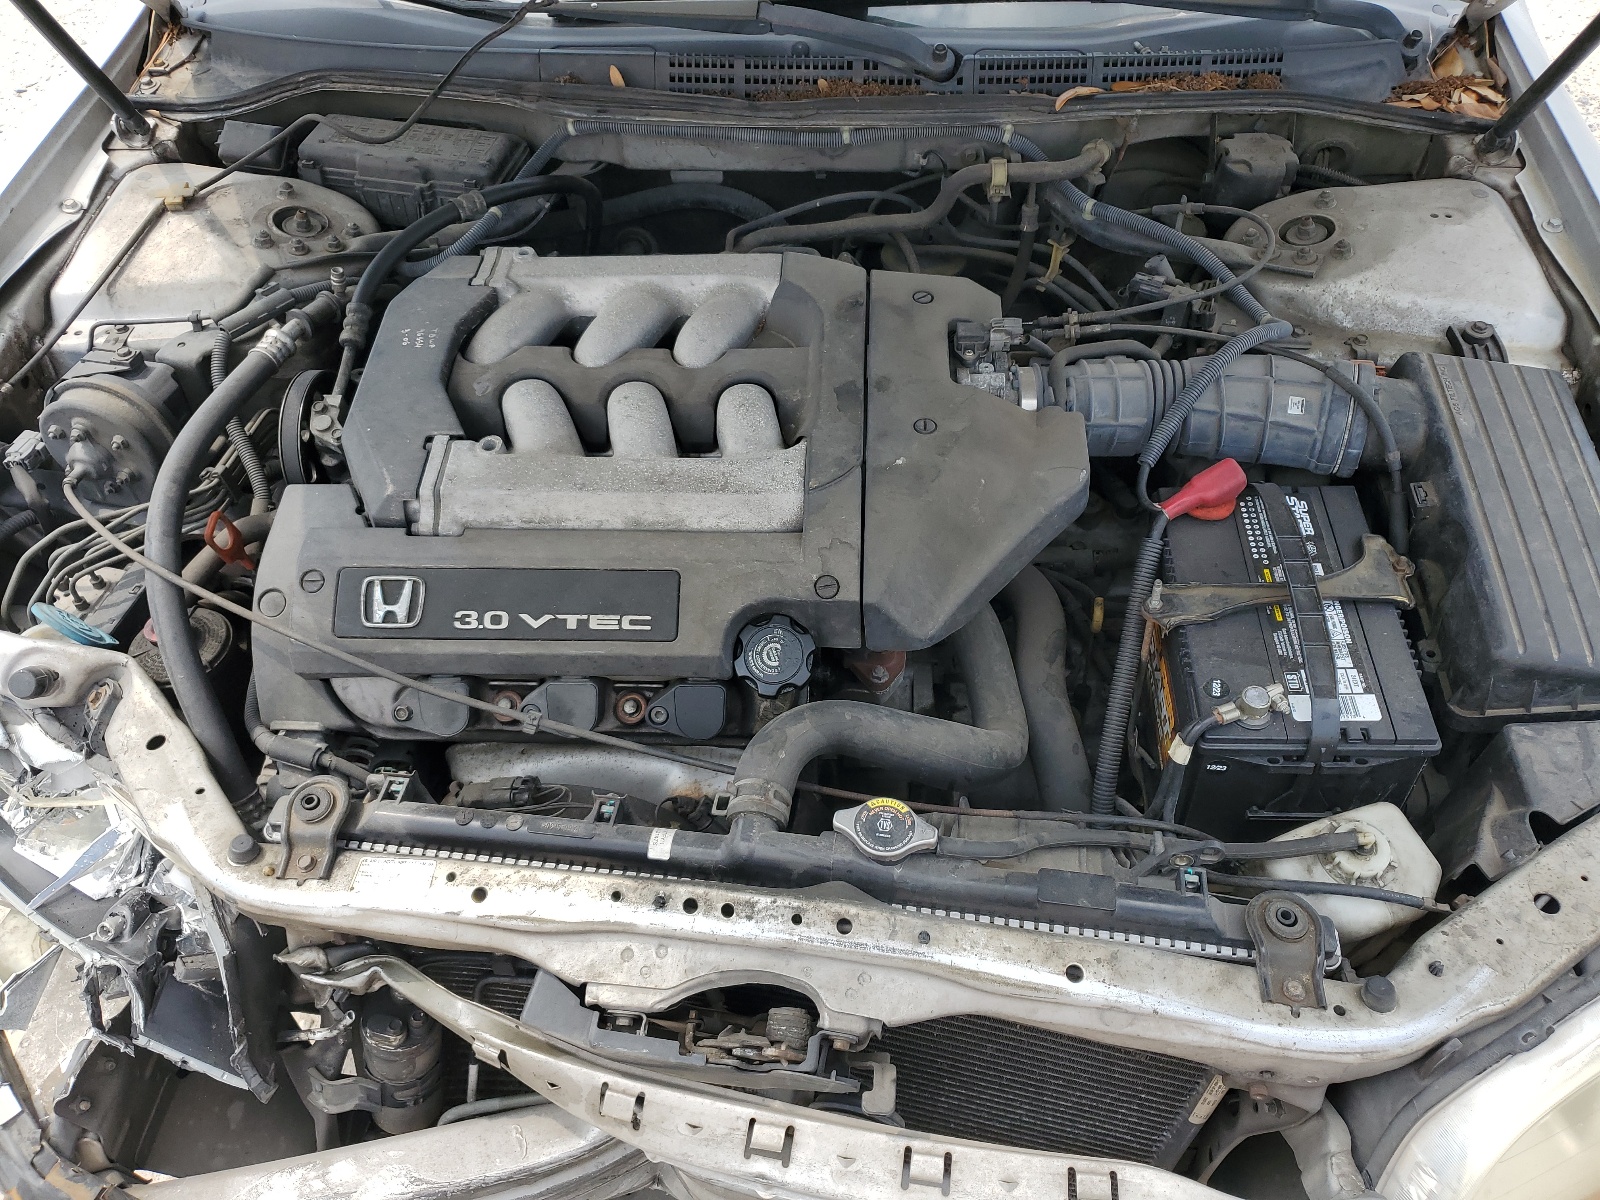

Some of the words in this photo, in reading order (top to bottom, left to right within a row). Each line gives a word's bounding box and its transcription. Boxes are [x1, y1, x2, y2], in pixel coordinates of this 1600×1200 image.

[1285, 495, 1307, 537] STA
[1300, 500, 1315, 536] SUPER
[453, 610, 509, 630] 3.0
[518, 613, 652, 630] VTEC
[1286, 674, 1300, 690] STD
